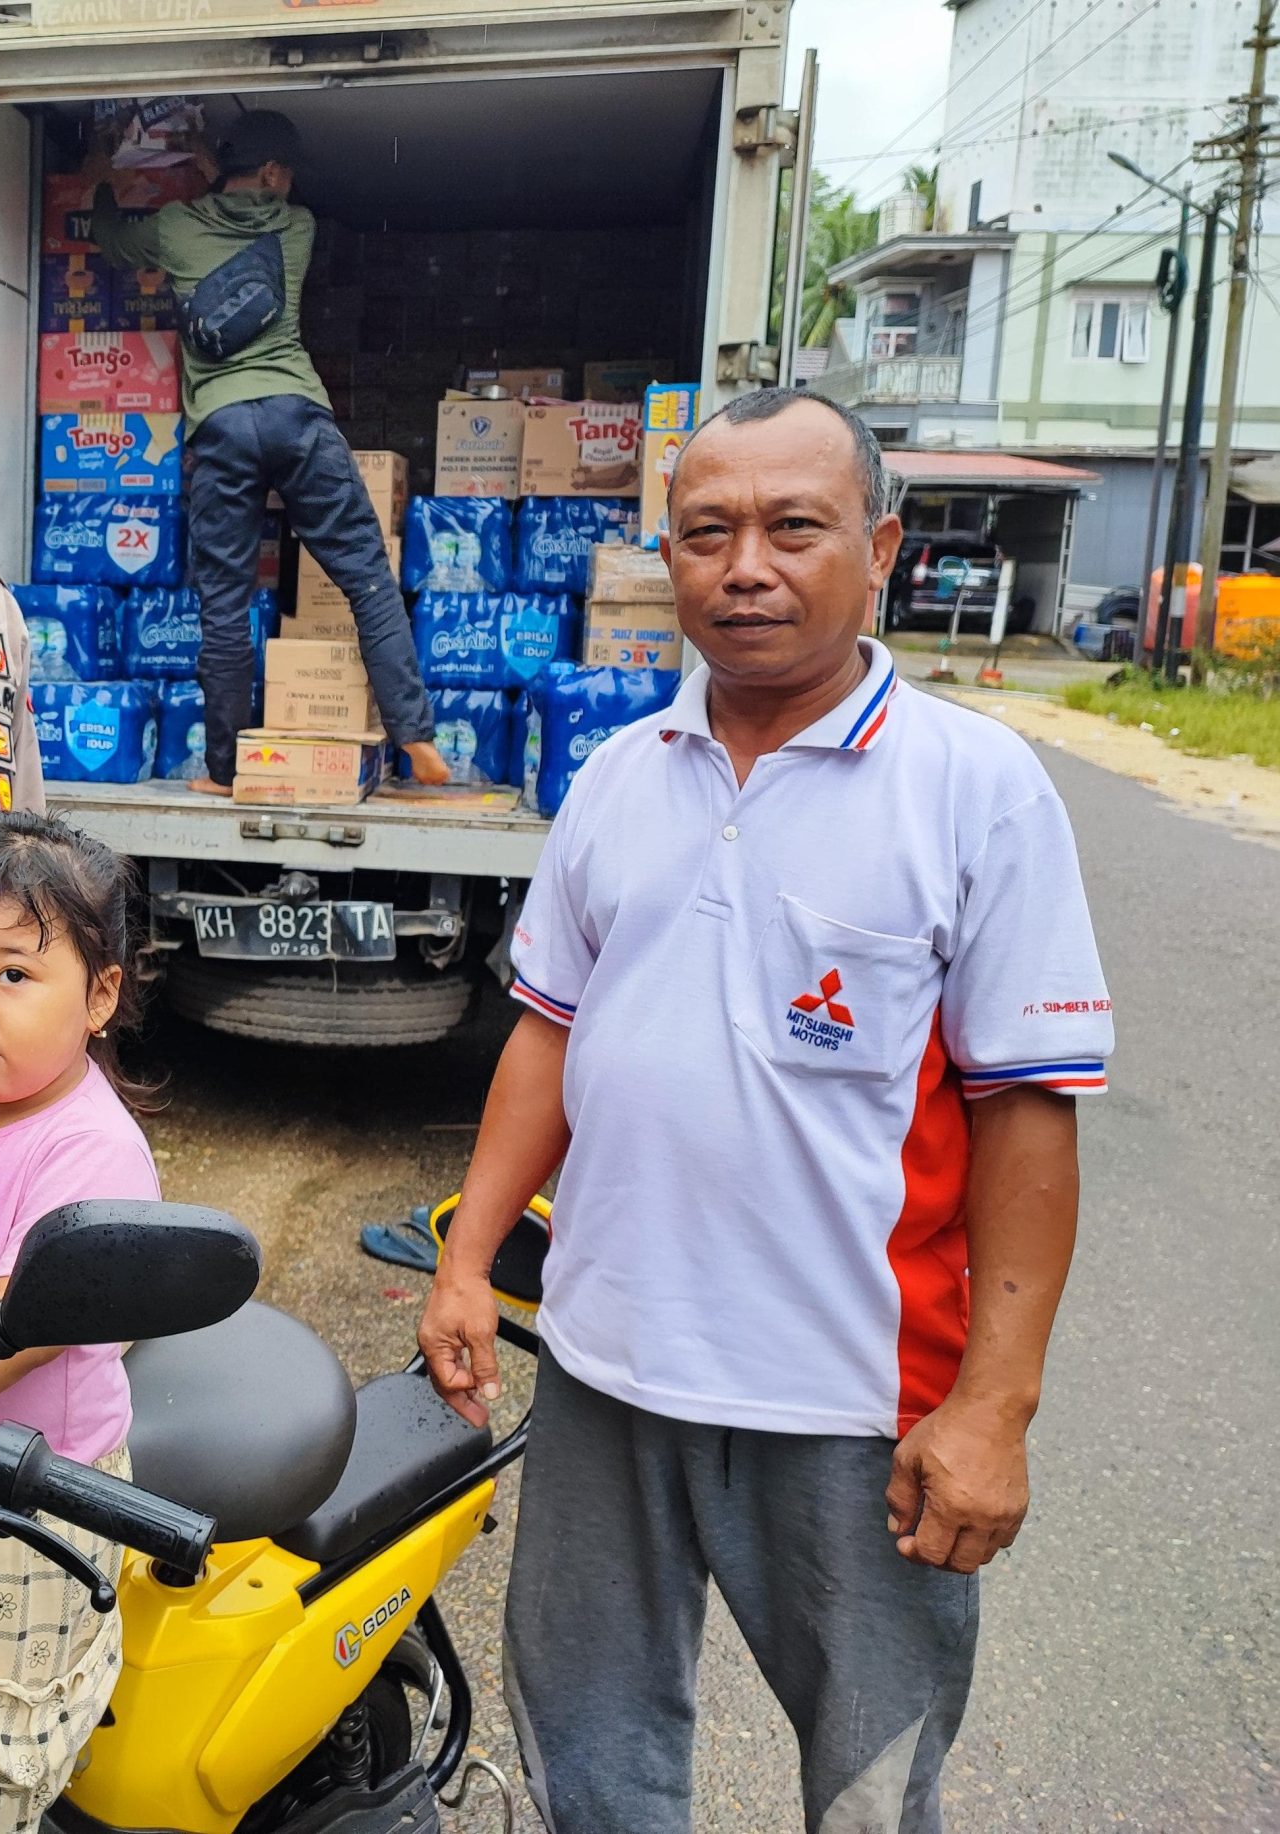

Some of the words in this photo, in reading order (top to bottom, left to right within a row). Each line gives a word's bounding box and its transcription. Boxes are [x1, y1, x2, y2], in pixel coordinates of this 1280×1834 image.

[67, 347, 132, 375] Tango
[69, 428, 134, 455] Tango
[117, 528, 150, 551] 2X
[197, 907, 236, 939] KH
[258, 904, 329, 941] 8823
[350, 904, 392, 942] TA
[1042, 1001, 1089, 1013] SUMBER
[786, 1008, 854, 1042] MITSUBISHI
[789, 1024, 840, 1051] MOTORS
[362, 1587, 411, 1637] GODA
